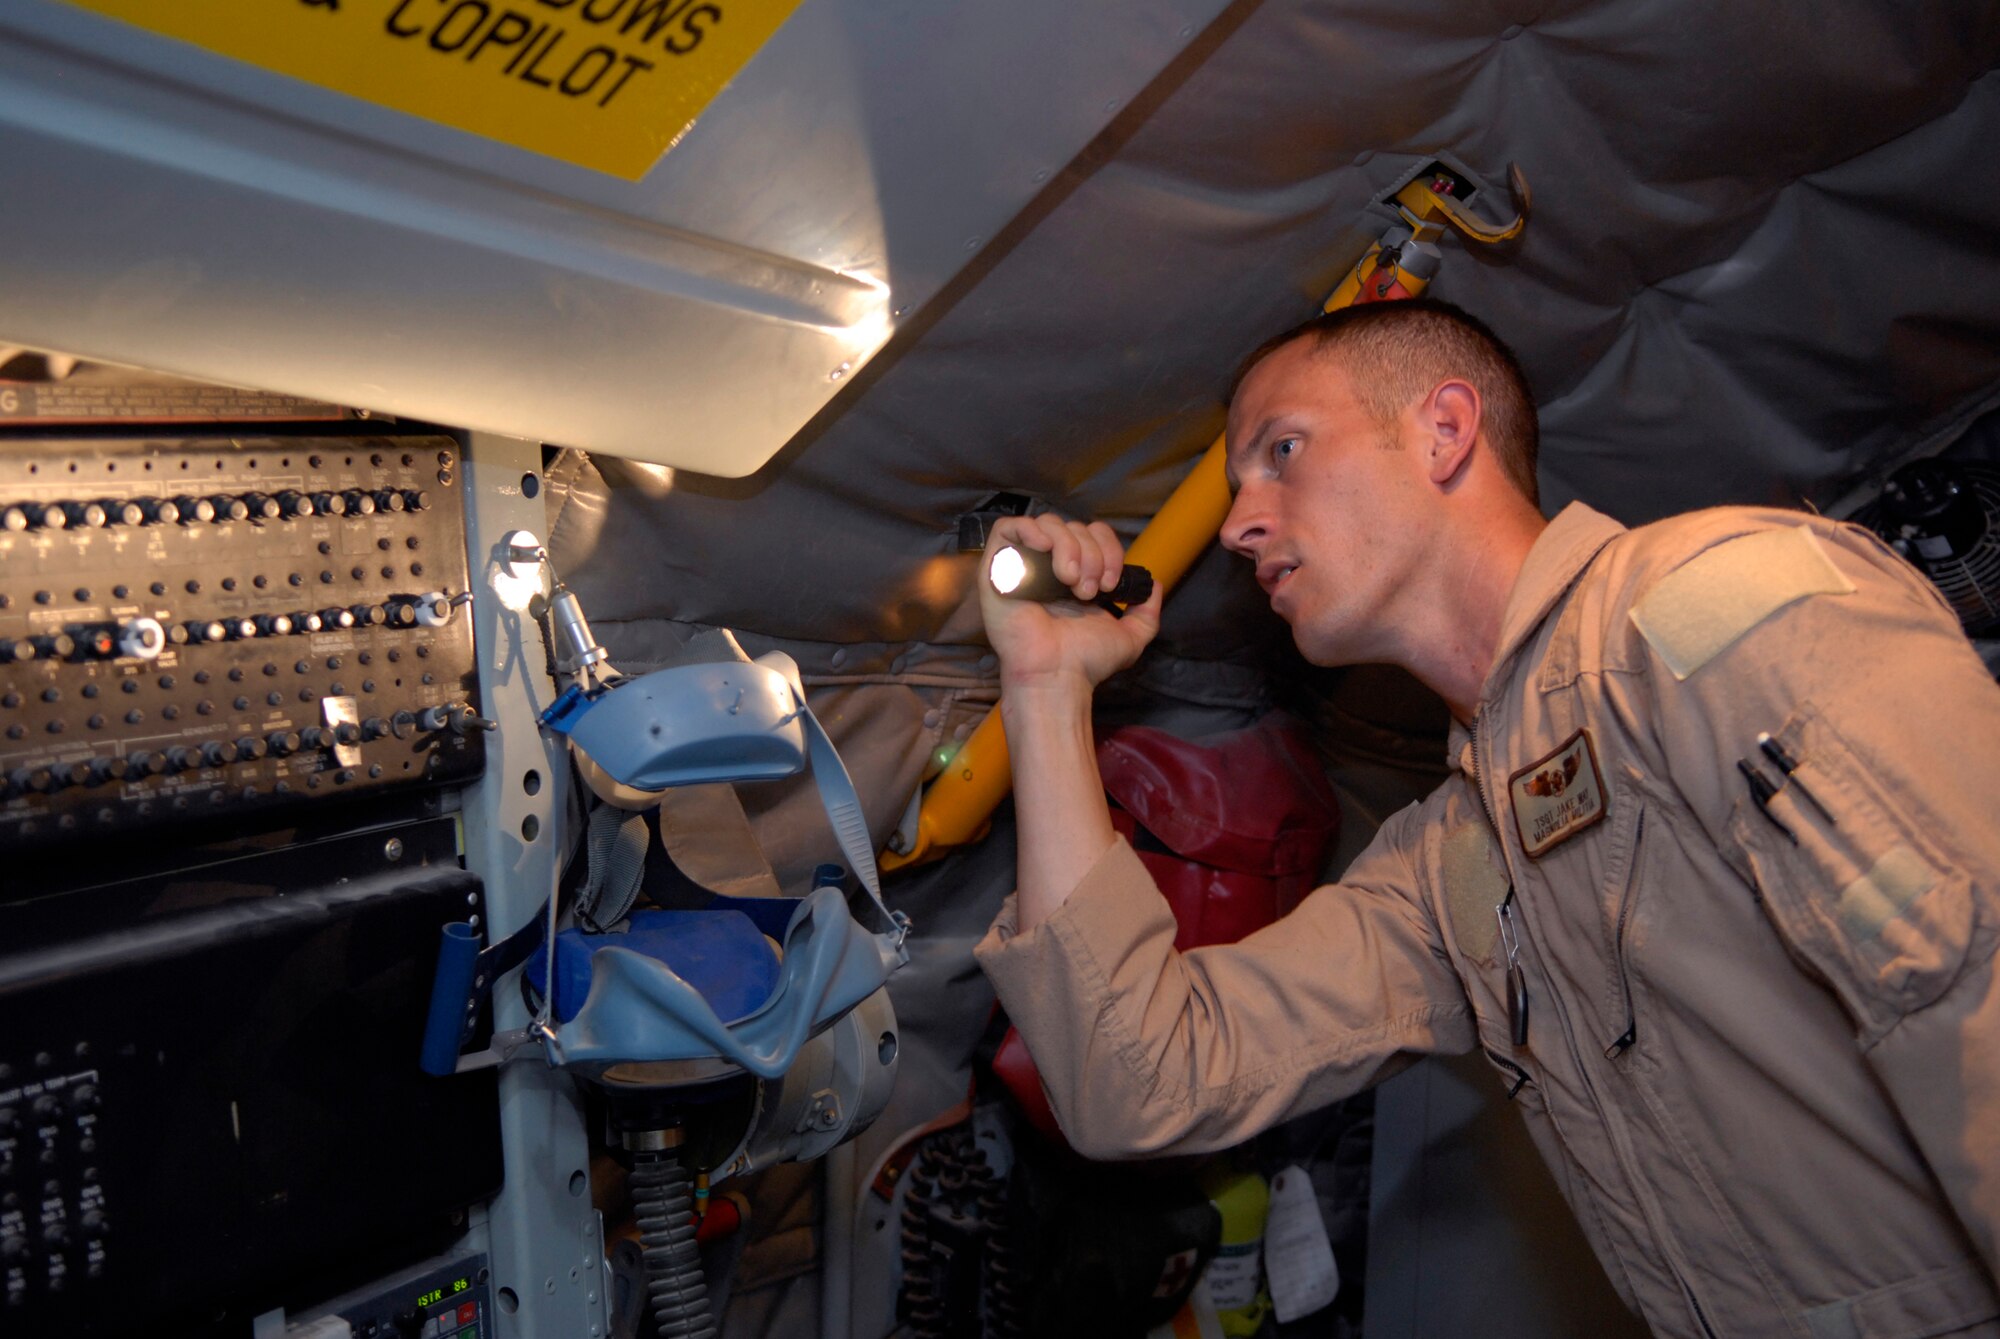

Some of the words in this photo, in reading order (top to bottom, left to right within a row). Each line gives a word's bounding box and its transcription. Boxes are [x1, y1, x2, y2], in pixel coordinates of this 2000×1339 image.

[385, 0, 655, 108] COPILOT
[1556, 797, 1575, 817] JAKE
[454, 1278, 468, 1292] 86
